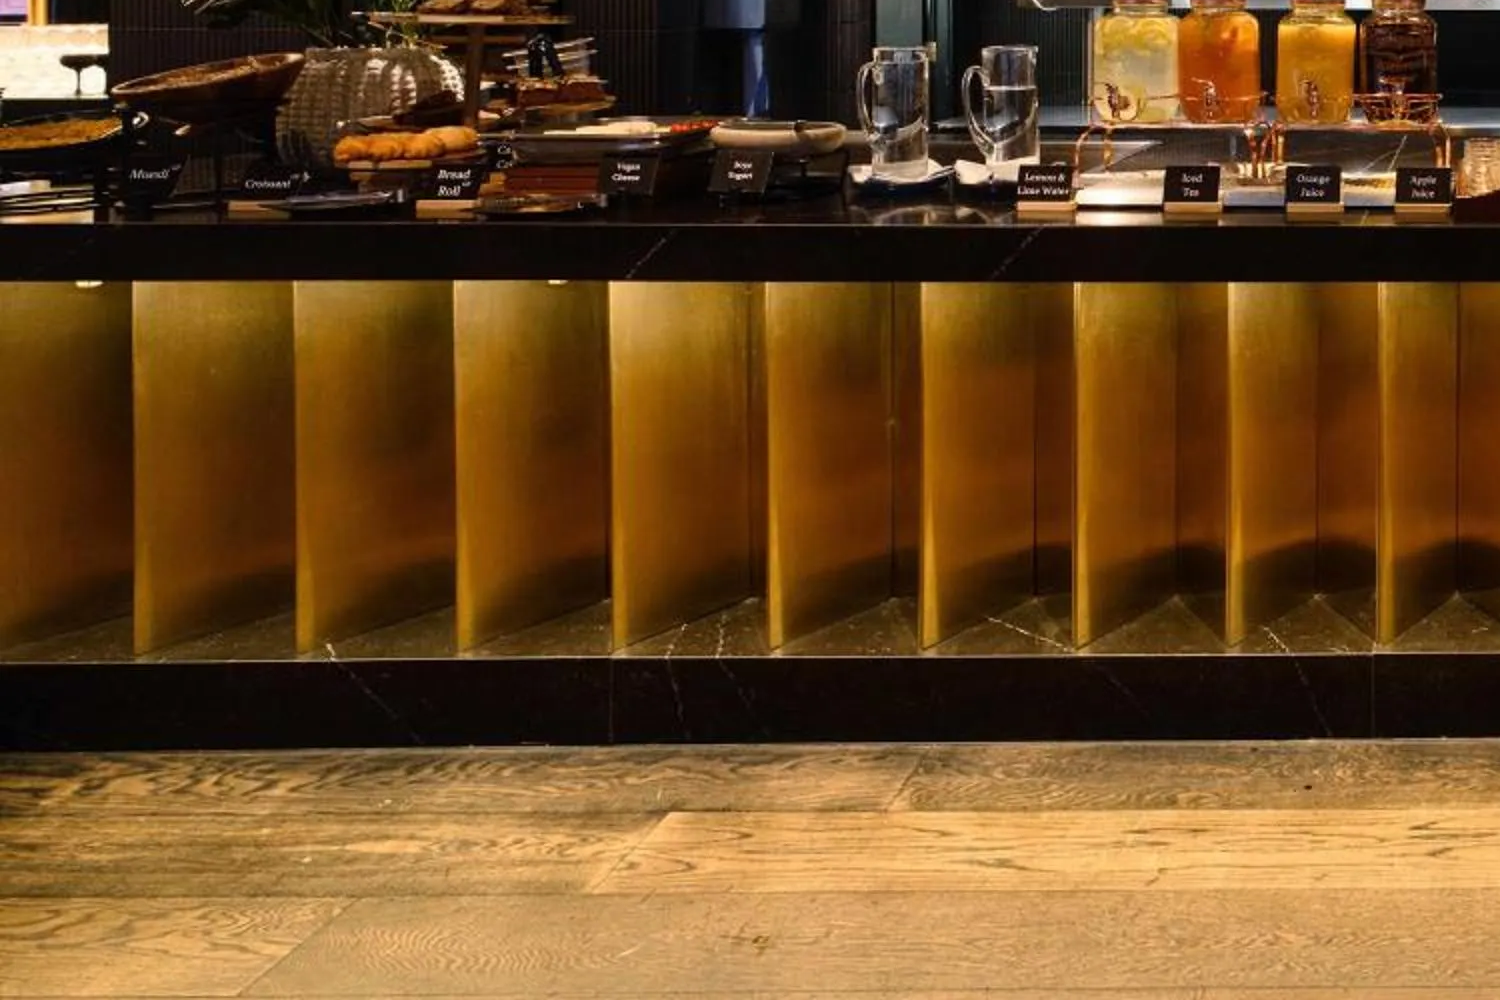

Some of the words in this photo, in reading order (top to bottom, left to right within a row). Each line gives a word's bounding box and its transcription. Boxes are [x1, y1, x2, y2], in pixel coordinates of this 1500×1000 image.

[437, 168, 471, 180] Bread
[1024, 172, 1057, 182] Lemon
[1058, 172, 1067, 184] &
[1182, 172, 1203, 183] Iced
[1296, 173, 1331, 185] Orange
[1409, 174, 1437, 187] Apple
[437, 185, 461, 197] Roll
[1017, 185, 1041, 195] Lime
[1042, 185, 1069, 196] Water
[1183, 187, 1200, 197] Tea
[1300, 187, 1325, 198] Juice
[1411, 188, 1436, 199] Juice
